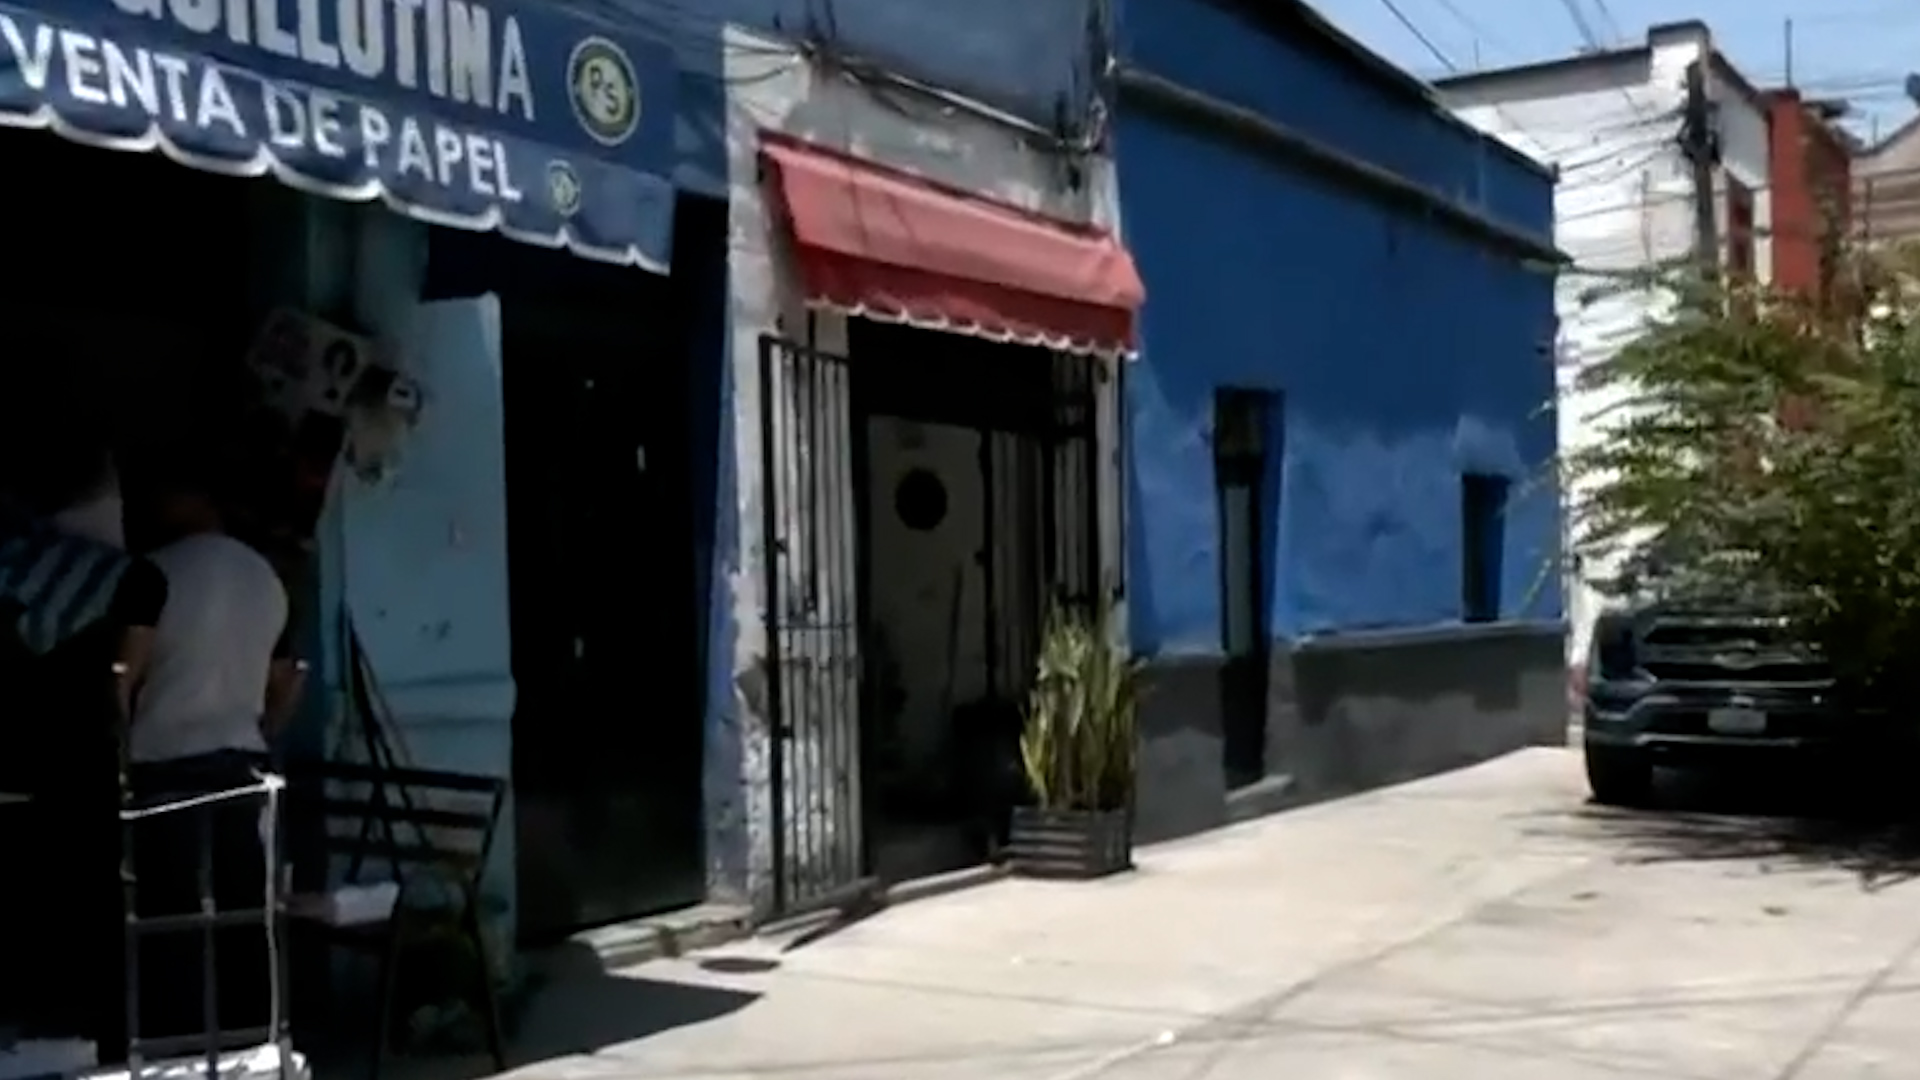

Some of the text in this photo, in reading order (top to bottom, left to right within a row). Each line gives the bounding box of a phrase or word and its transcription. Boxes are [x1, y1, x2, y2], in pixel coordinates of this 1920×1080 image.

[0, 13, 247, 138] VENTA
[261, 80, 346, 158] DE
[359, 104, 523, 202] PAPEL
[111, 0, 535, 121] LLOTINA
